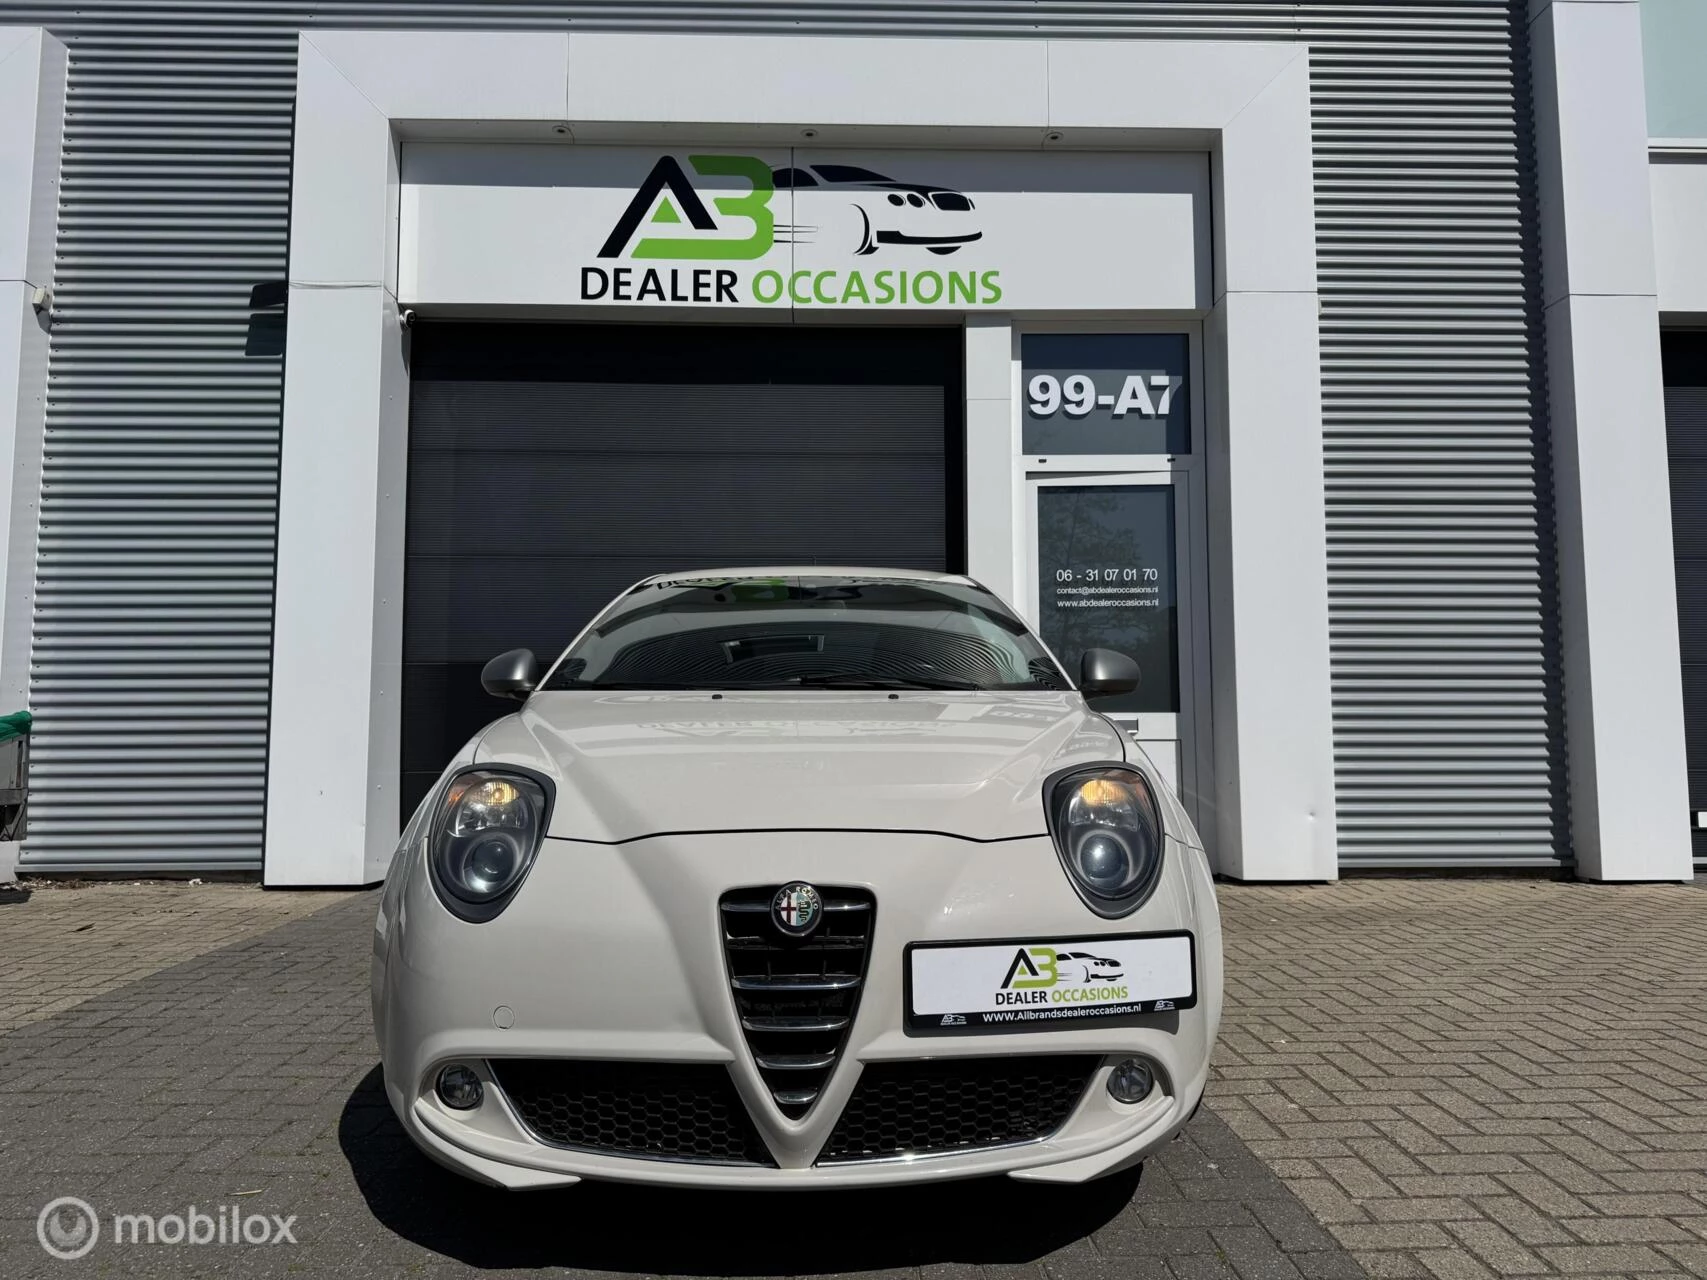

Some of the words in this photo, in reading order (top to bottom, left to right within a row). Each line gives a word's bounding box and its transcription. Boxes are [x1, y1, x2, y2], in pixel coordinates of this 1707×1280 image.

[581, 267, 738, 302] DEALER
[752, 270, 1002, 304] OCCASIONS
[1028, 375, 1182, 415] 99-A7
[1056, 569, 1073, 581] 06
[1086, 569, 1099, 581] 31
[1104, 569, 1119, 581] 07
[1123, 568, 1137, 580] 01
[1142, 568, 1158, 580] 70
[1056, 586, 1159, 595] contact@abdealeroccasions.nl
[1057, 598, 1159, 607] www.abdealeroccasions.nl
[995, 991, 1048, 1005] DEALER
[1051, 986, 1128, 1003] OCCASIONS
